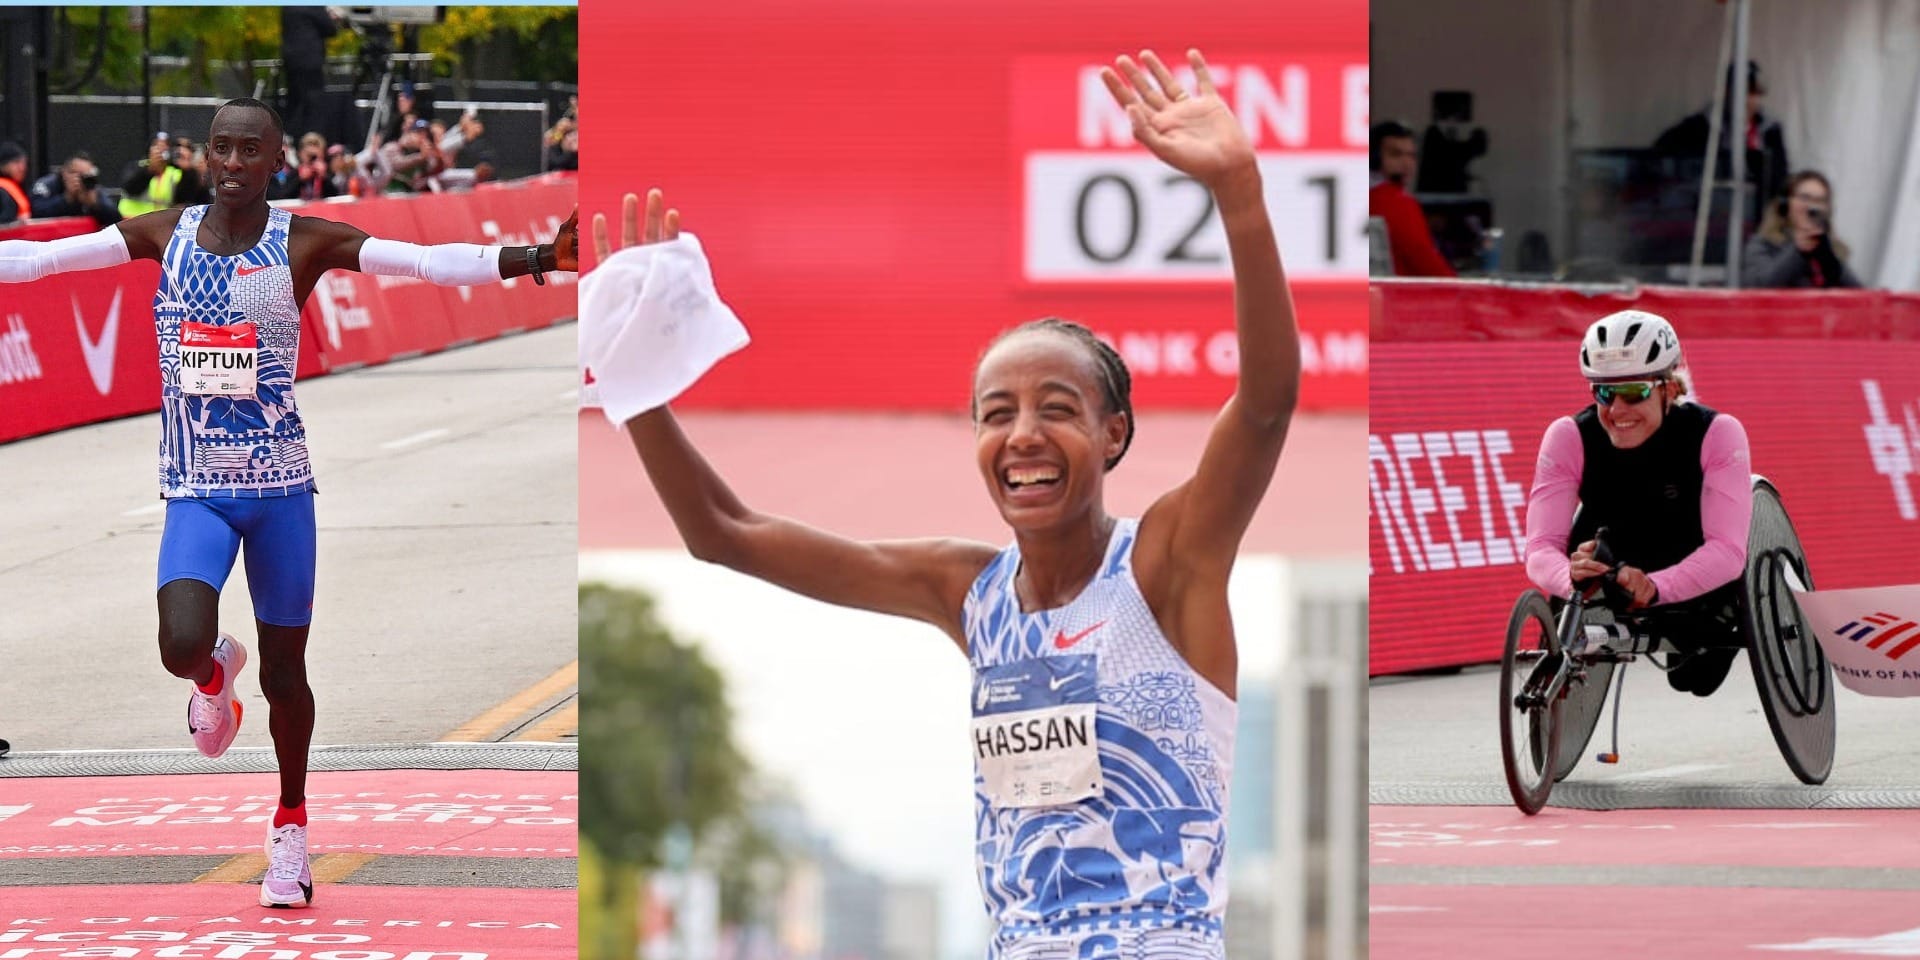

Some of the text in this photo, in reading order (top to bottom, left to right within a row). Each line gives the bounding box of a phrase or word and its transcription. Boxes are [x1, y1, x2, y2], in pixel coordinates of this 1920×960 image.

[1305, 175, 1369, 262] 1
[181, 350, 253, 369] KIPTUM
[1096, 331, 1198, 376] NK
[1369, 429, 1527, 576] REEZE
[1876, 669, 1896, 679] OF
[975, 716, 1088, 758] HASSAN
[97, 795, 280, 803] BANK
[150, 843, 384, 851] MARAON
[404, 845, 573, 853] MAJORS
[80, 916, 181, 924] OF
[199, 916, 563, 929] AMERICA
